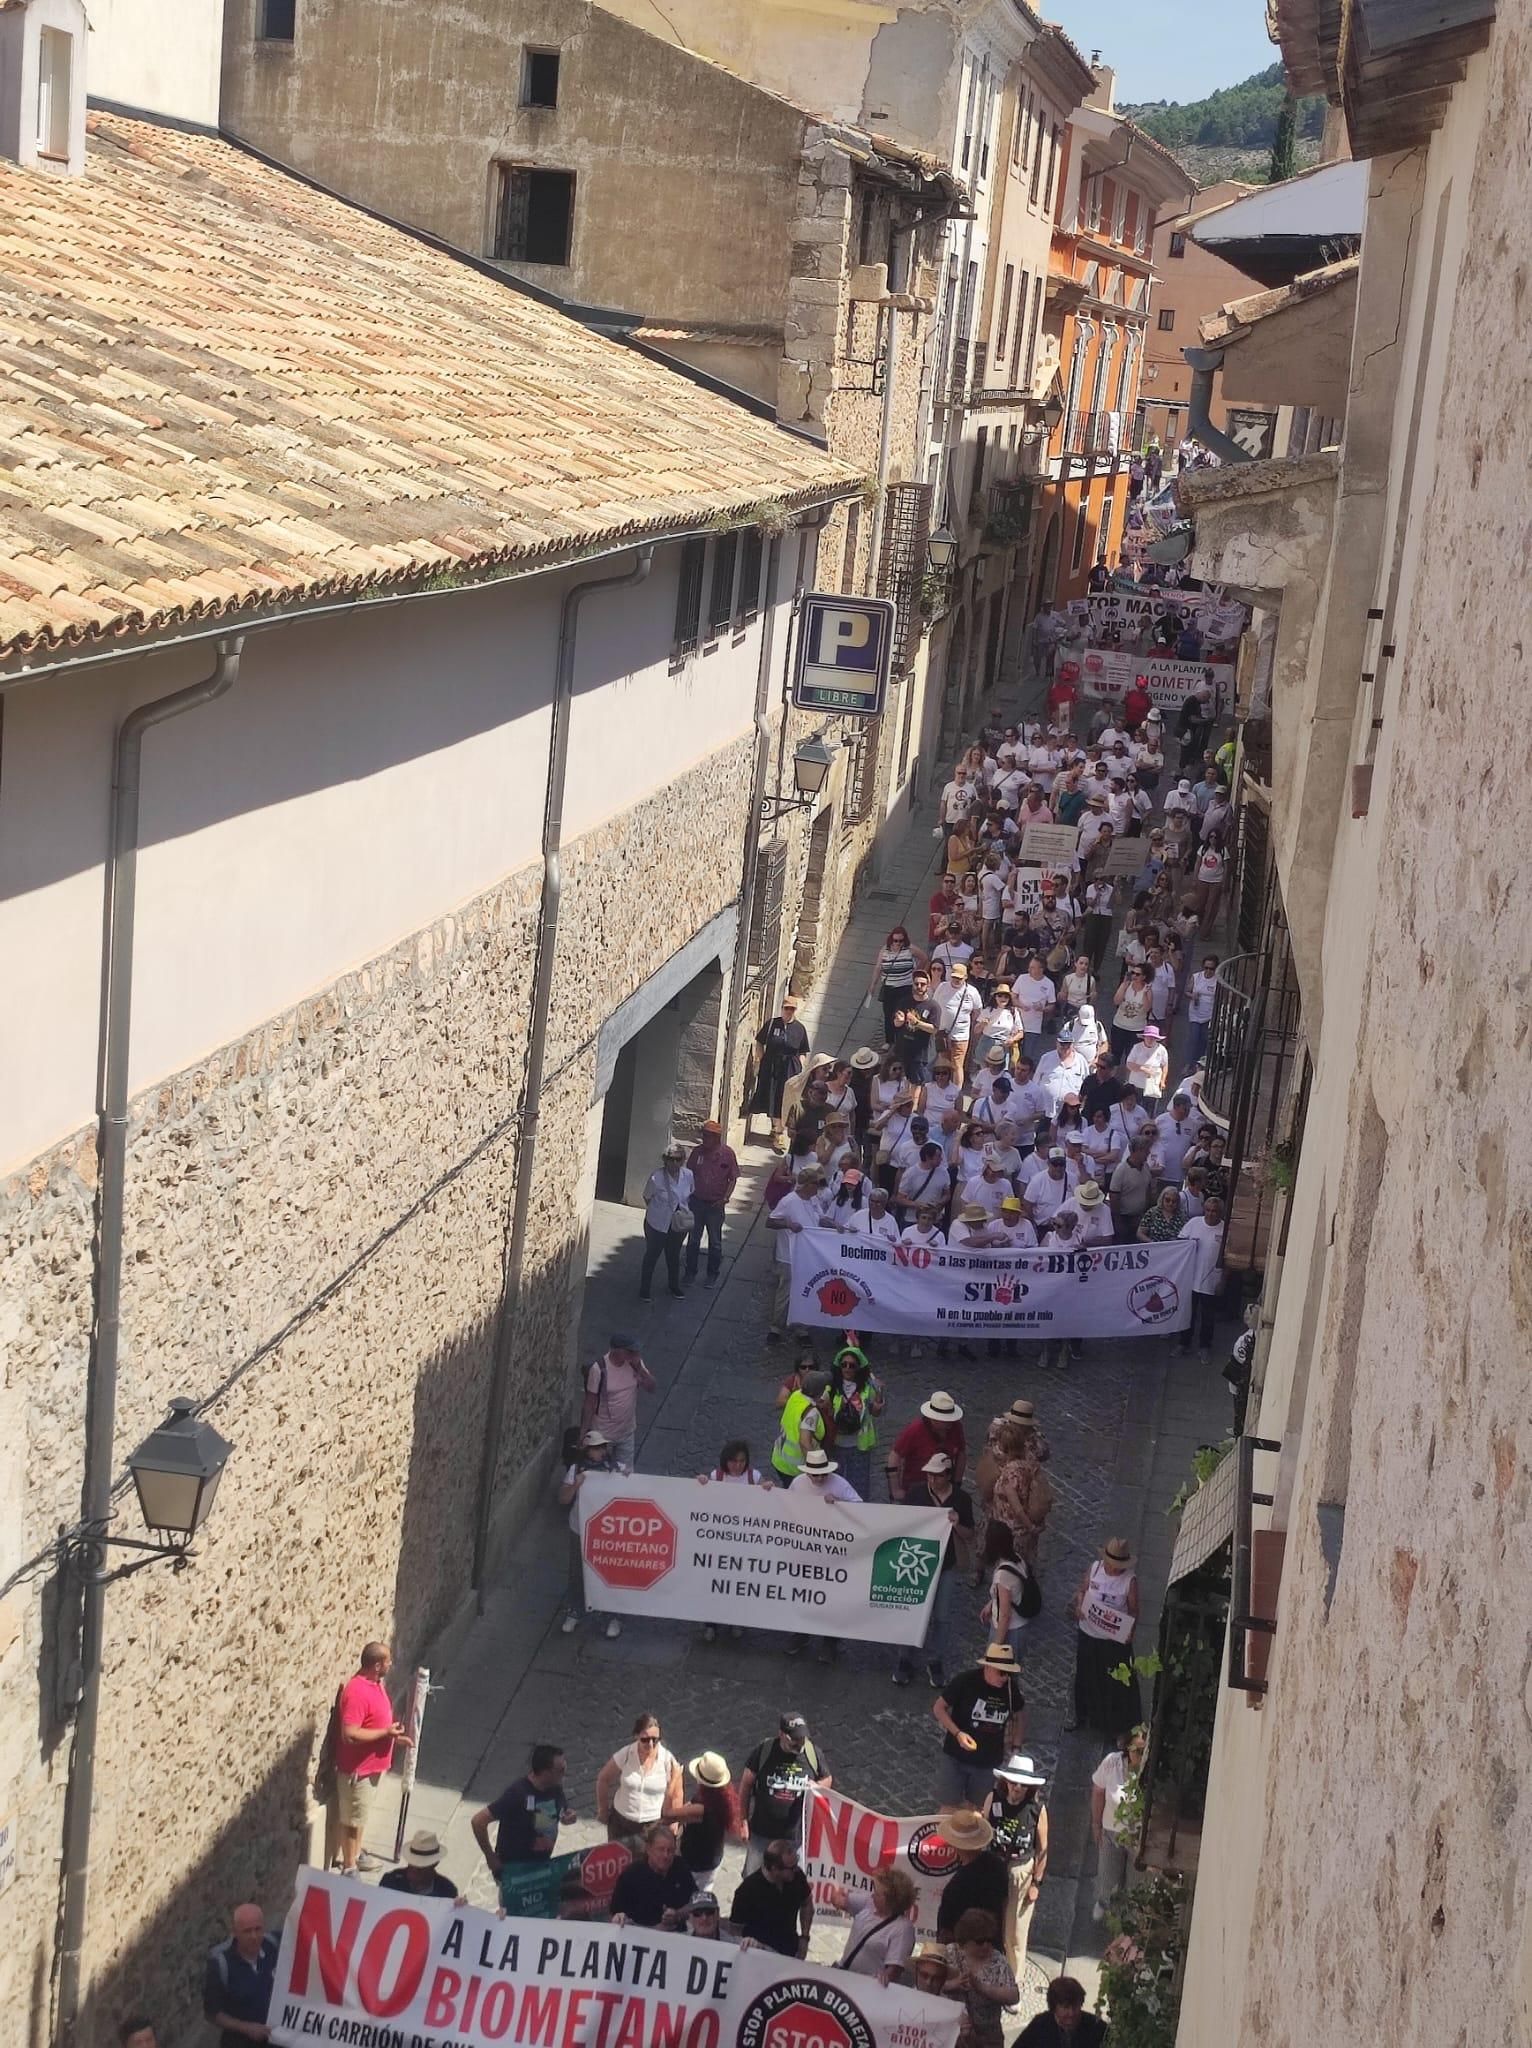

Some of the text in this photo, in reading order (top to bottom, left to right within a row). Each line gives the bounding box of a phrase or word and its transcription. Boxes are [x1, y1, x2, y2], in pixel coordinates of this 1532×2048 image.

[1088, 596, 1120, 610] TOP
[819, 609, 870, 664] P
[1150, 663, 1157, 671] A
[1160, 664, 1170, 672] LA
[820, 689, 858, 704] LIBRE
[841, 1244, 887, 1261] Decimos
[892, 1245, 931, 1269] NO
[939, 1256, 946, 1267] a
[949, 1255, 966, 1267] las
[968, 1257, 1012, 1270] plantas
[1015, 1258, 1028, 1270] de
[831, 1290, 847, 1305] NO
[937, 1308, 946, 1320] Ni
[948, 1310, 959, 1320] en
[962, 1309, 971, 1321] tu
[973, 1309, 1002, 1322] pueblo
[1014, 1311, 1026, 1321] en
[1027, 1310, 1036, 1321] el
[601, 1515, 663, 1537] STOP
[690, 1511, 854, 1543] NO NOS HAN PREGUNTADO
[592, 1538, 669, 1555] BIOMETANO
[696, 1528, 763, 1545] CONSULTA
[766, 1535, 822, 1553] POPULAR
[592, 1555, 667, 1570] MANZANARES
[693, 1552, 848, 1583] NI EN TU PUEBLO
[711, 1579, 827, 1605] NI EN EL MIO
[872, 1584, 924, 1596] ecologistas
[886, 1594, 919, 1604] acción
[807, 1796, 899, 1876] NO
[922, 1844, 955, 1857] STOP
[585, 1855, 629, 1883] STOP
[806, 1863, 813, 1877] A
[820, 1864, 836, 1880] LA
[288, 1885, 430, 2018] NO
[441, 1918, 734, 1999] A LA PLANTA DE
[424, 1966, 721, 2048] BIOMETANO
[743, 2008, 764, 2047] STOP
[763, 1985, 818, 2009] PLANTA
[281, 2004, 300, 2031] NI
[302, 2011, 326, 2037] EN
[328, 2017, 405, 2048] CARRIÓN
[897, 2023, 928, 2038] STOP
